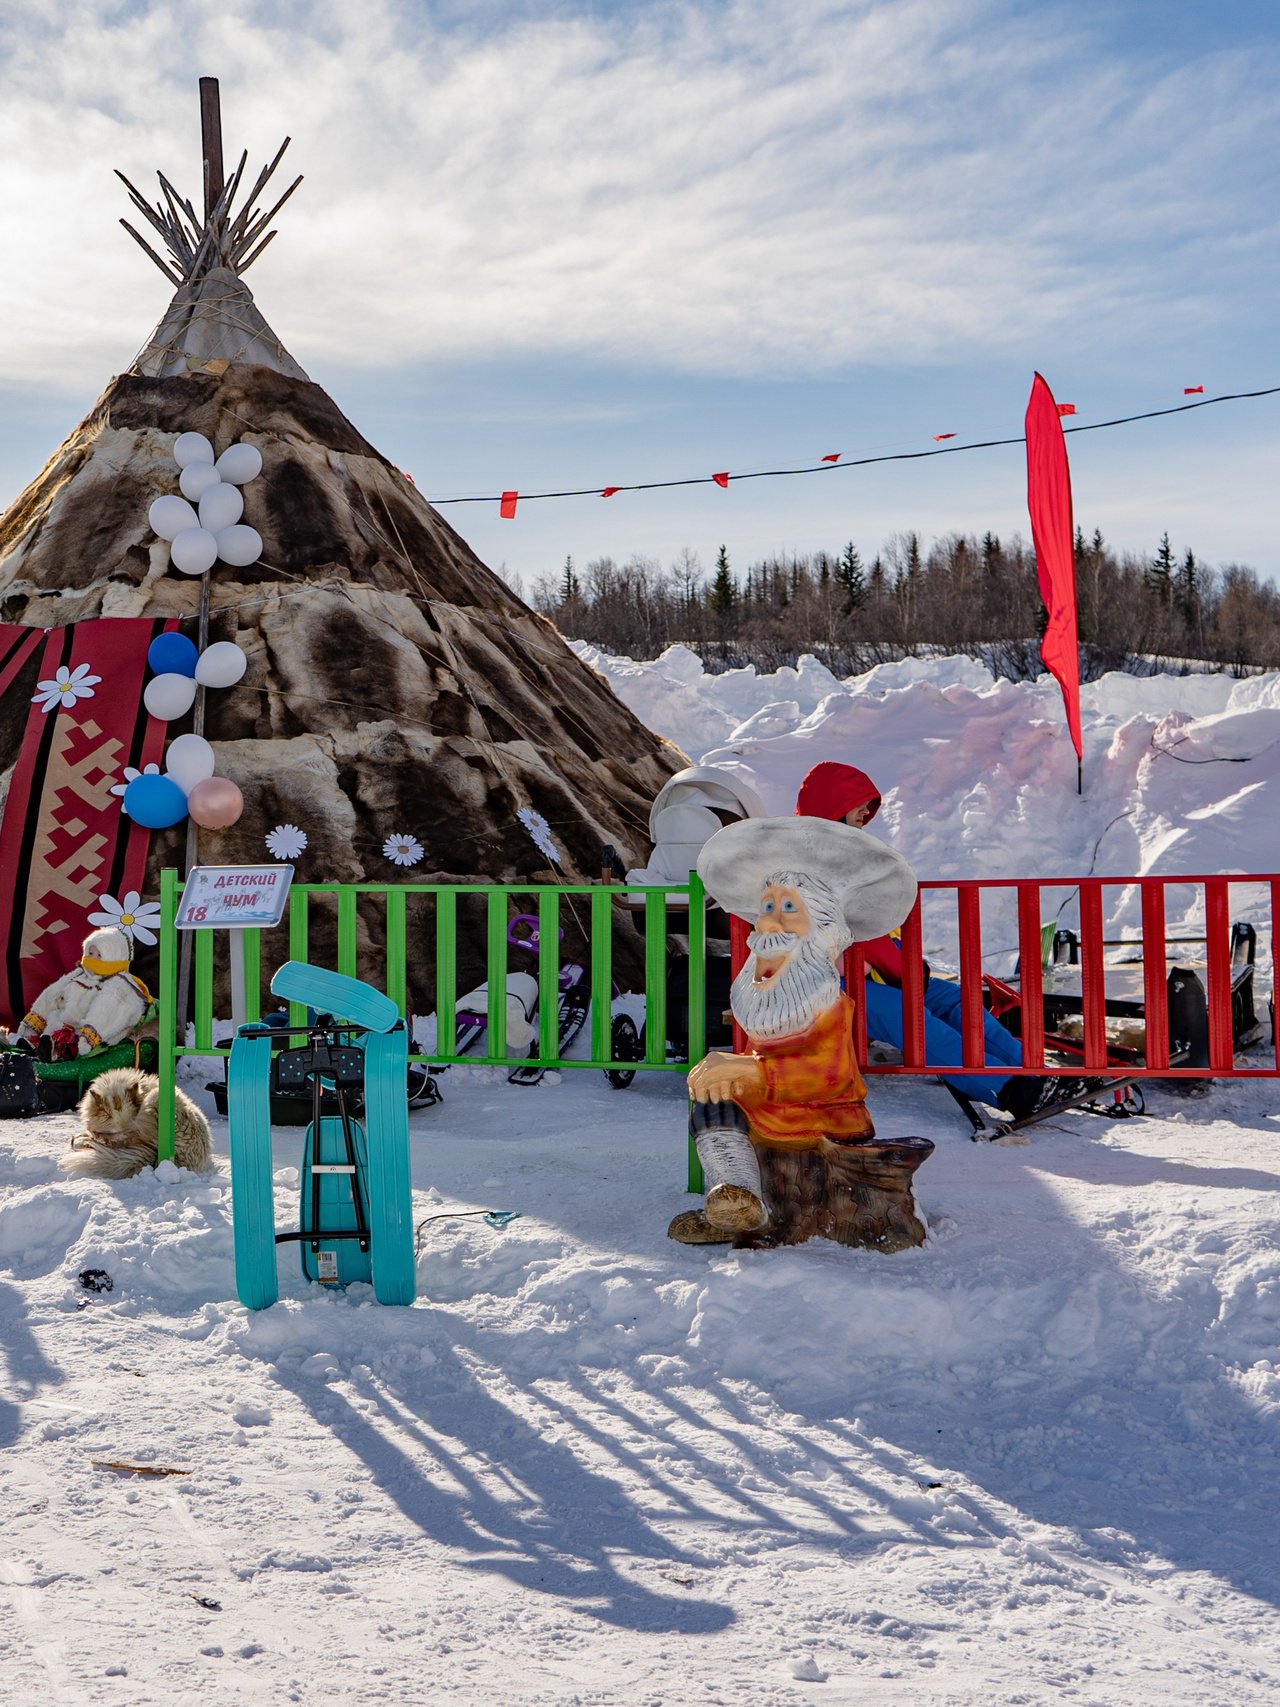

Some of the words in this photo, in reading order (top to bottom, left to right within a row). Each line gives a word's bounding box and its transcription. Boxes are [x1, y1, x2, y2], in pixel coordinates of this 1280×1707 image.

[214, 873, 277, 889] ДЕТСКИЙ
[223, 893, 258, 907] ЧУМ
[187, 906, 208, 922] 18
